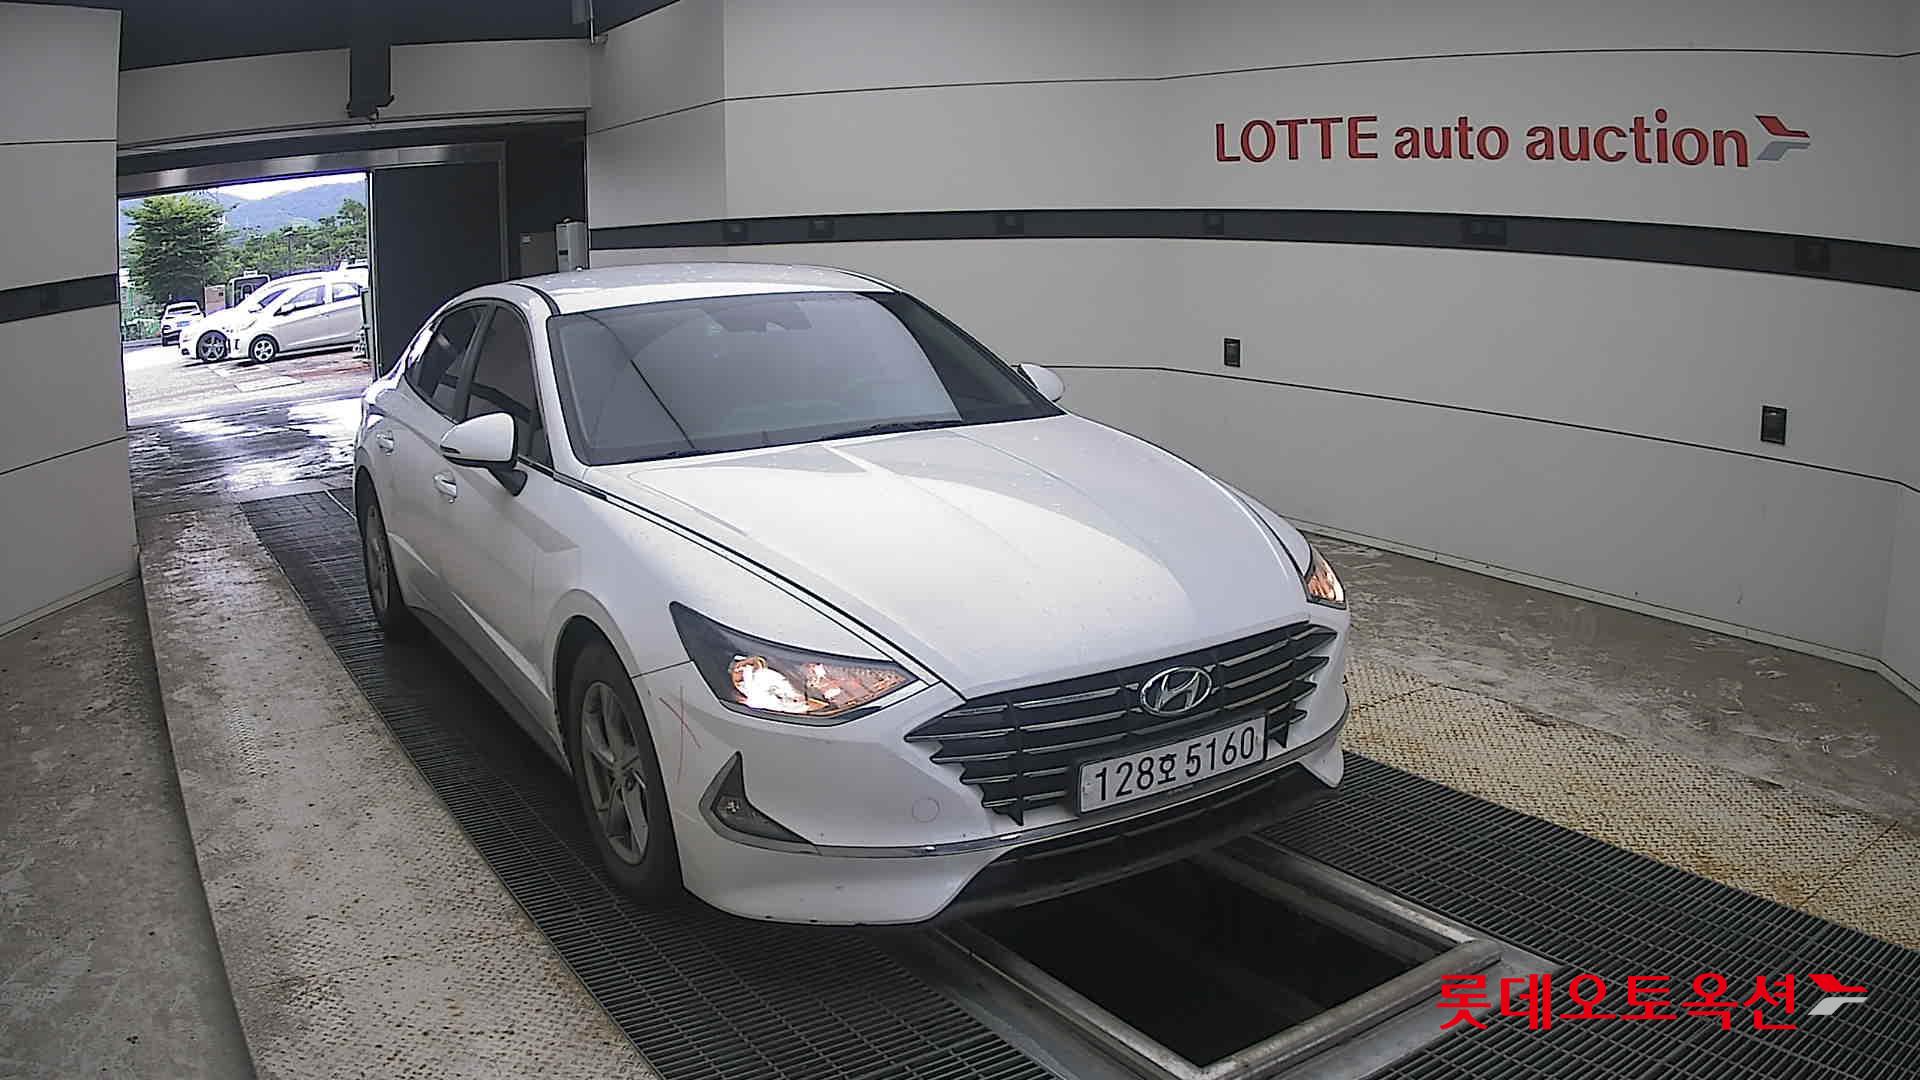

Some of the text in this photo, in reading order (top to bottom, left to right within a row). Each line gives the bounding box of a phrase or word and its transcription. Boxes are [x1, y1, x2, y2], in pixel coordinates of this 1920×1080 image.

[1215, 109, 1750, 167] LOTTE auto auction
[1186, 726, 1255, 777] 5160
